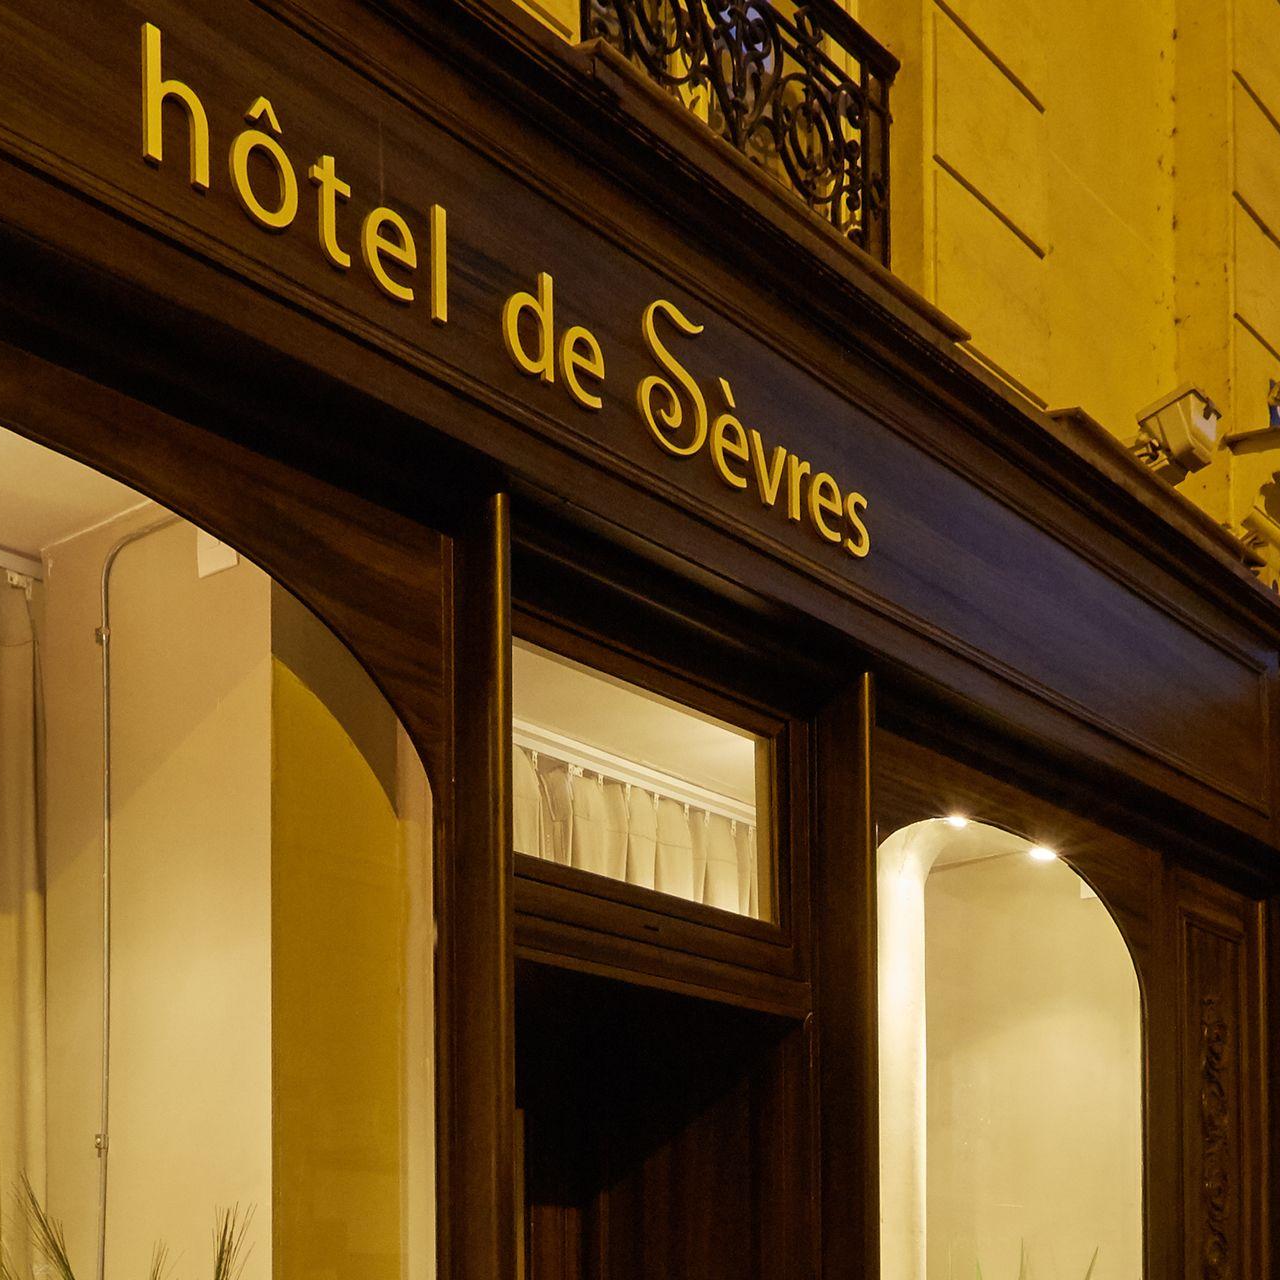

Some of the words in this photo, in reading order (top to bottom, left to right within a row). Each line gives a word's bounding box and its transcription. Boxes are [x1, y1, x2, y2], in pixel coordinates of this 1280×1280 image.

[140, 21, 450, 325] hôtel
[501, 271, 607, 411] de
[635, 298, 871, 560] Sèvres
